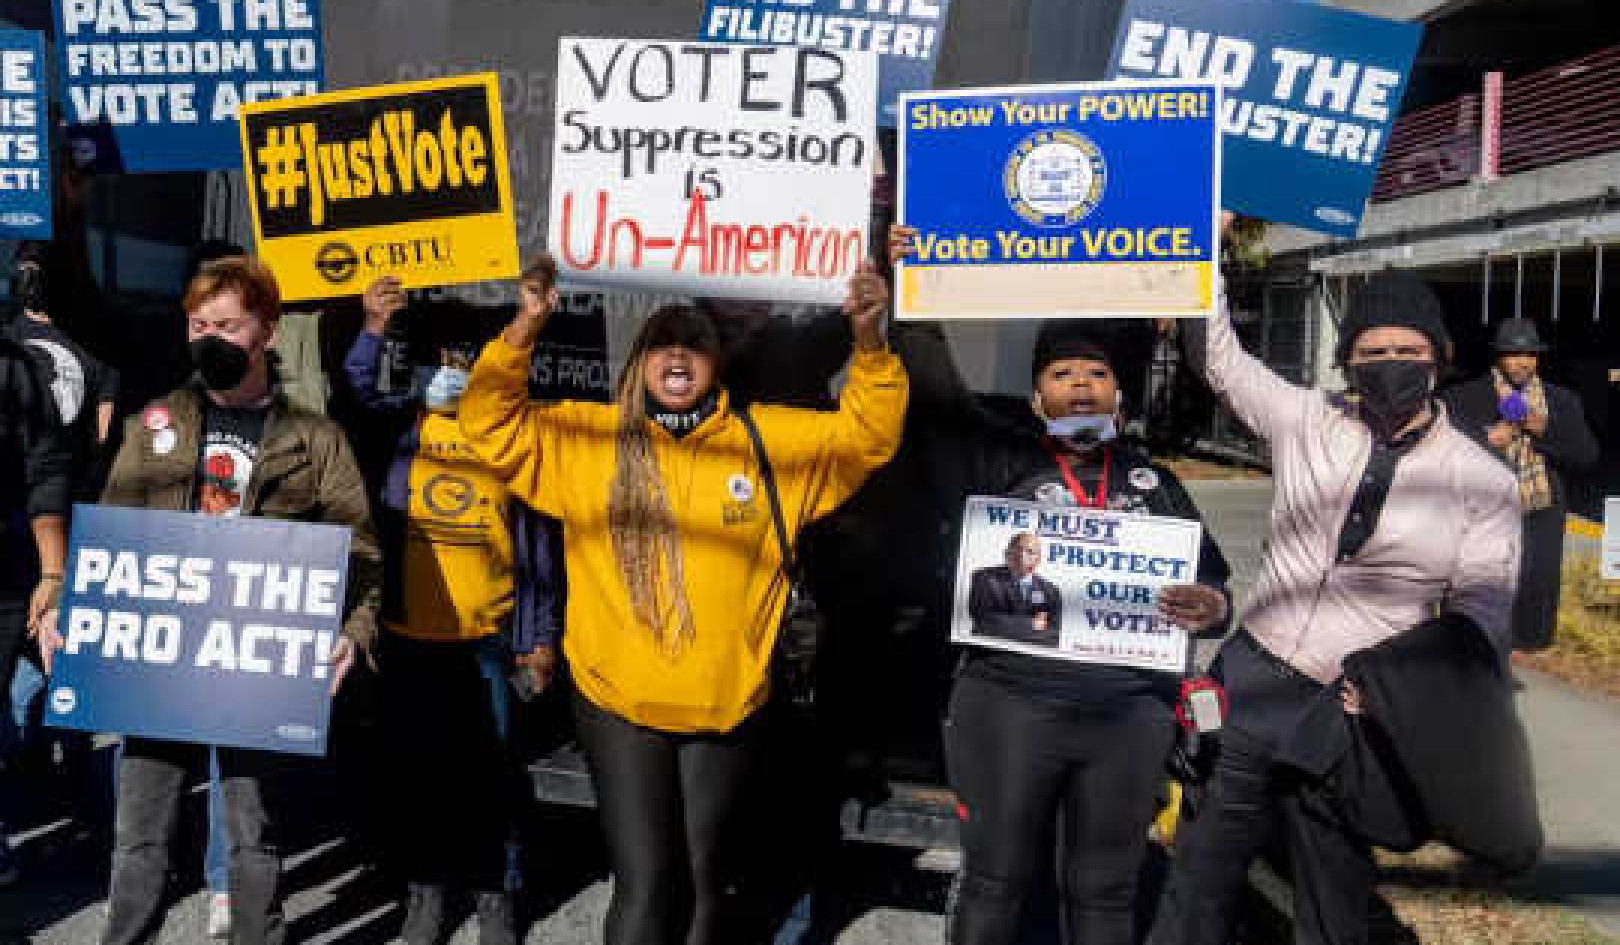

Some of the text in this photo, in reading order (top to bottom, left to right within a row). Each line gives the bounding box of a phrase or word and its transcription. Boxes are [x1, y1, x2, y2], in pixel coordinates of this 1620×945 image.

[63, 0, 314, 34] PASS THE
[708, 6, 937, 59] FILIBUSTER!
[68, 38, 316, 77] FREEDOM TO
[1120, 18, 1402, 121] END THE
[69, 83, 199, 124] VOTE
[572, 43, 847, 122] VOTER
[911, 92, 1207, 129] Show Your POWER!
[1221, 98, 1382, 163] USTER!
[257, 106, 488, 226] #JustVote
[561, 110, 865, 179] Suppression
[365, 236, 453, 269] CBTU
[560, 187, 861, 278] Un-American
[912, 226, 1201, 261] Vote Your VOICE.
[985, 505, 1120, 539] WE MUST
[73, 546, 341, 616] PASS THE
[1047, 543, 1188, 579] PROTECT
[1085, 580, 1151, 604] OUR
[65, 607, 335, 679] PRO ACT!
